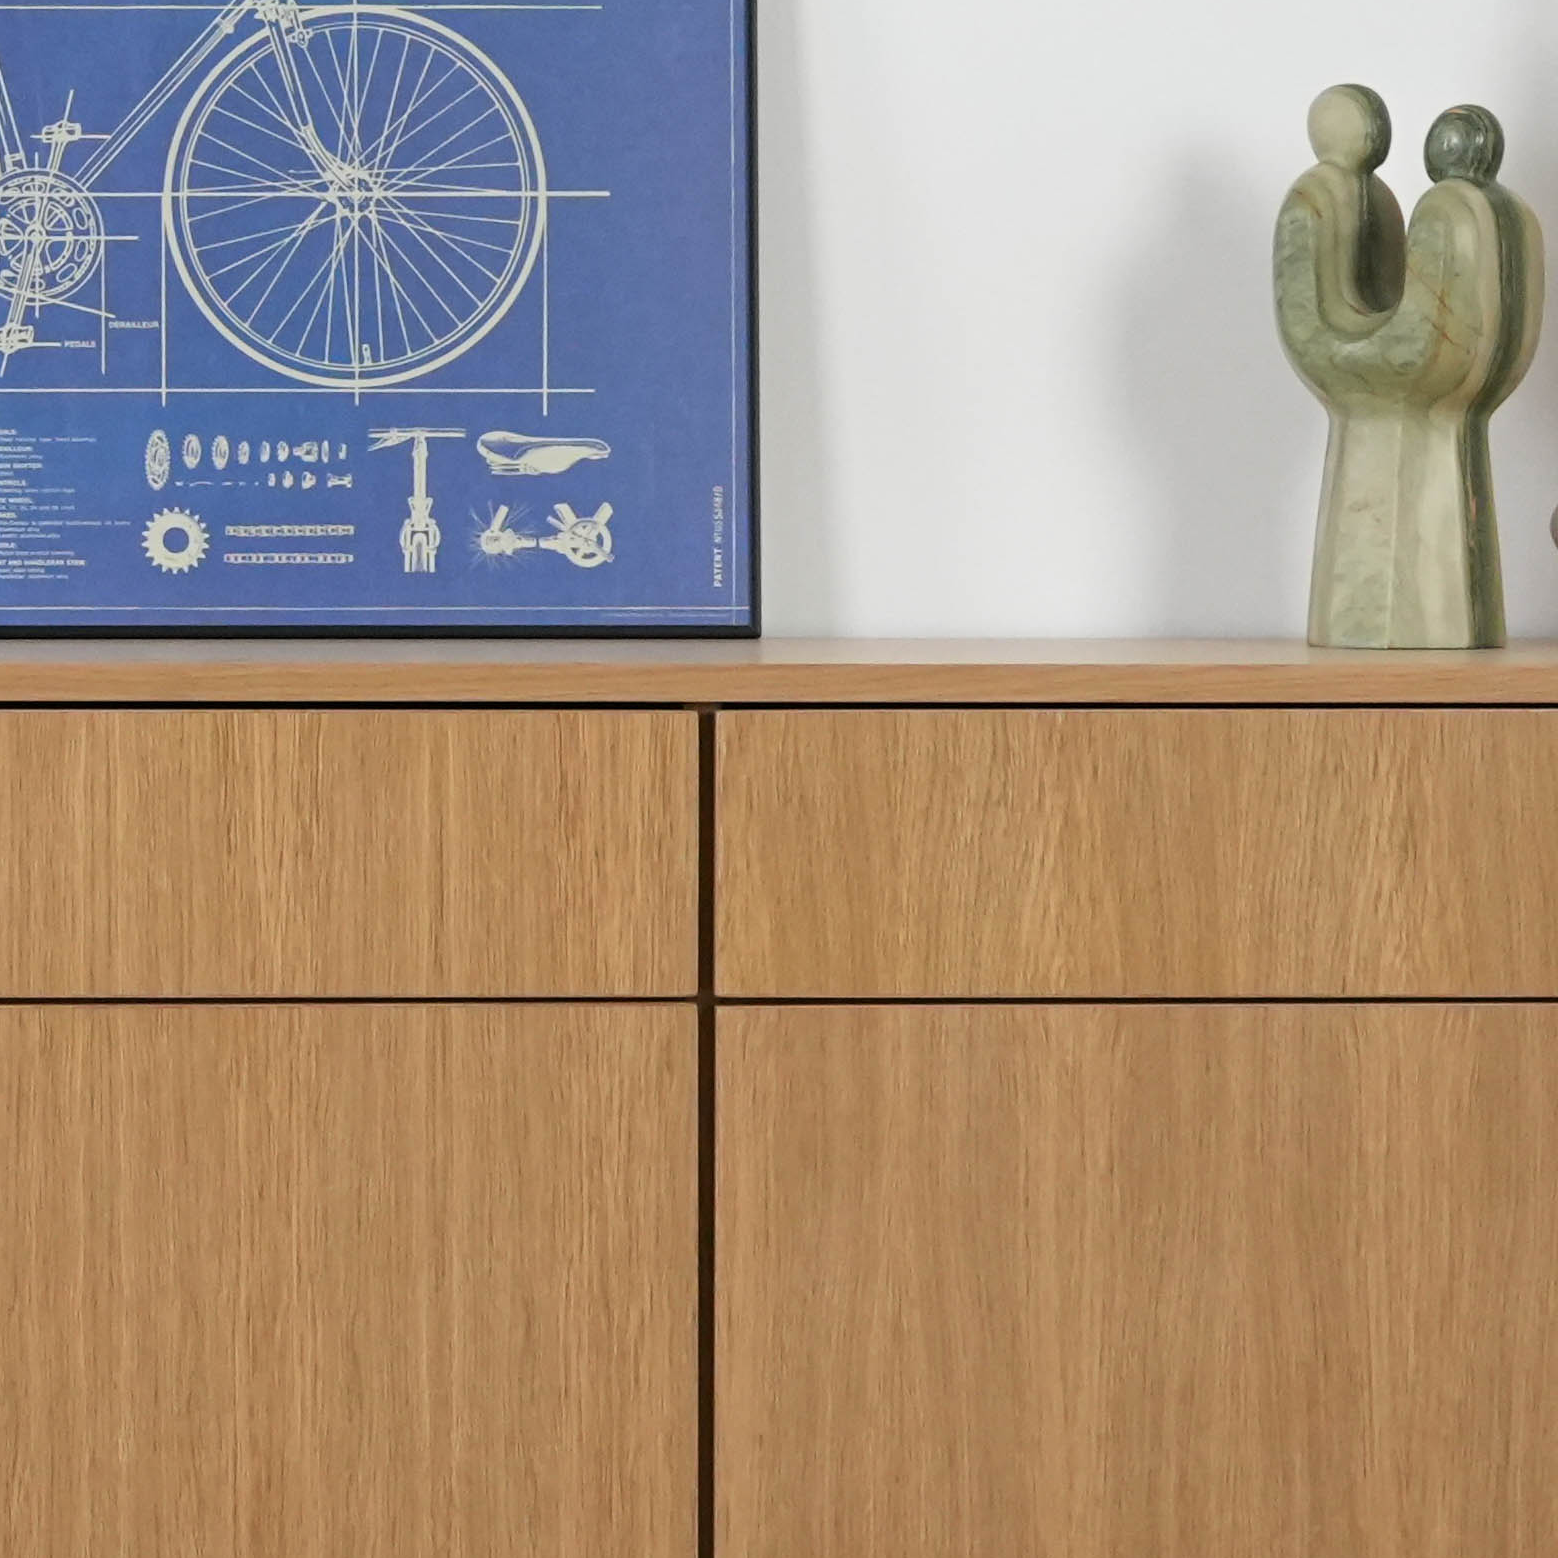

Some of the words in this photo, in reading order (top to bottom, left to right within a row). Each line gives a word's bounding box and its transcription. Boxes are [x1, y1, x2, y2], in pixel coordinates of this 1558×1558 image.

[108, 321, 159, 329] DERAILLEUR
[64, 340, 96, 349] PEDALS
[712, 548, 724, 588] PATENT
